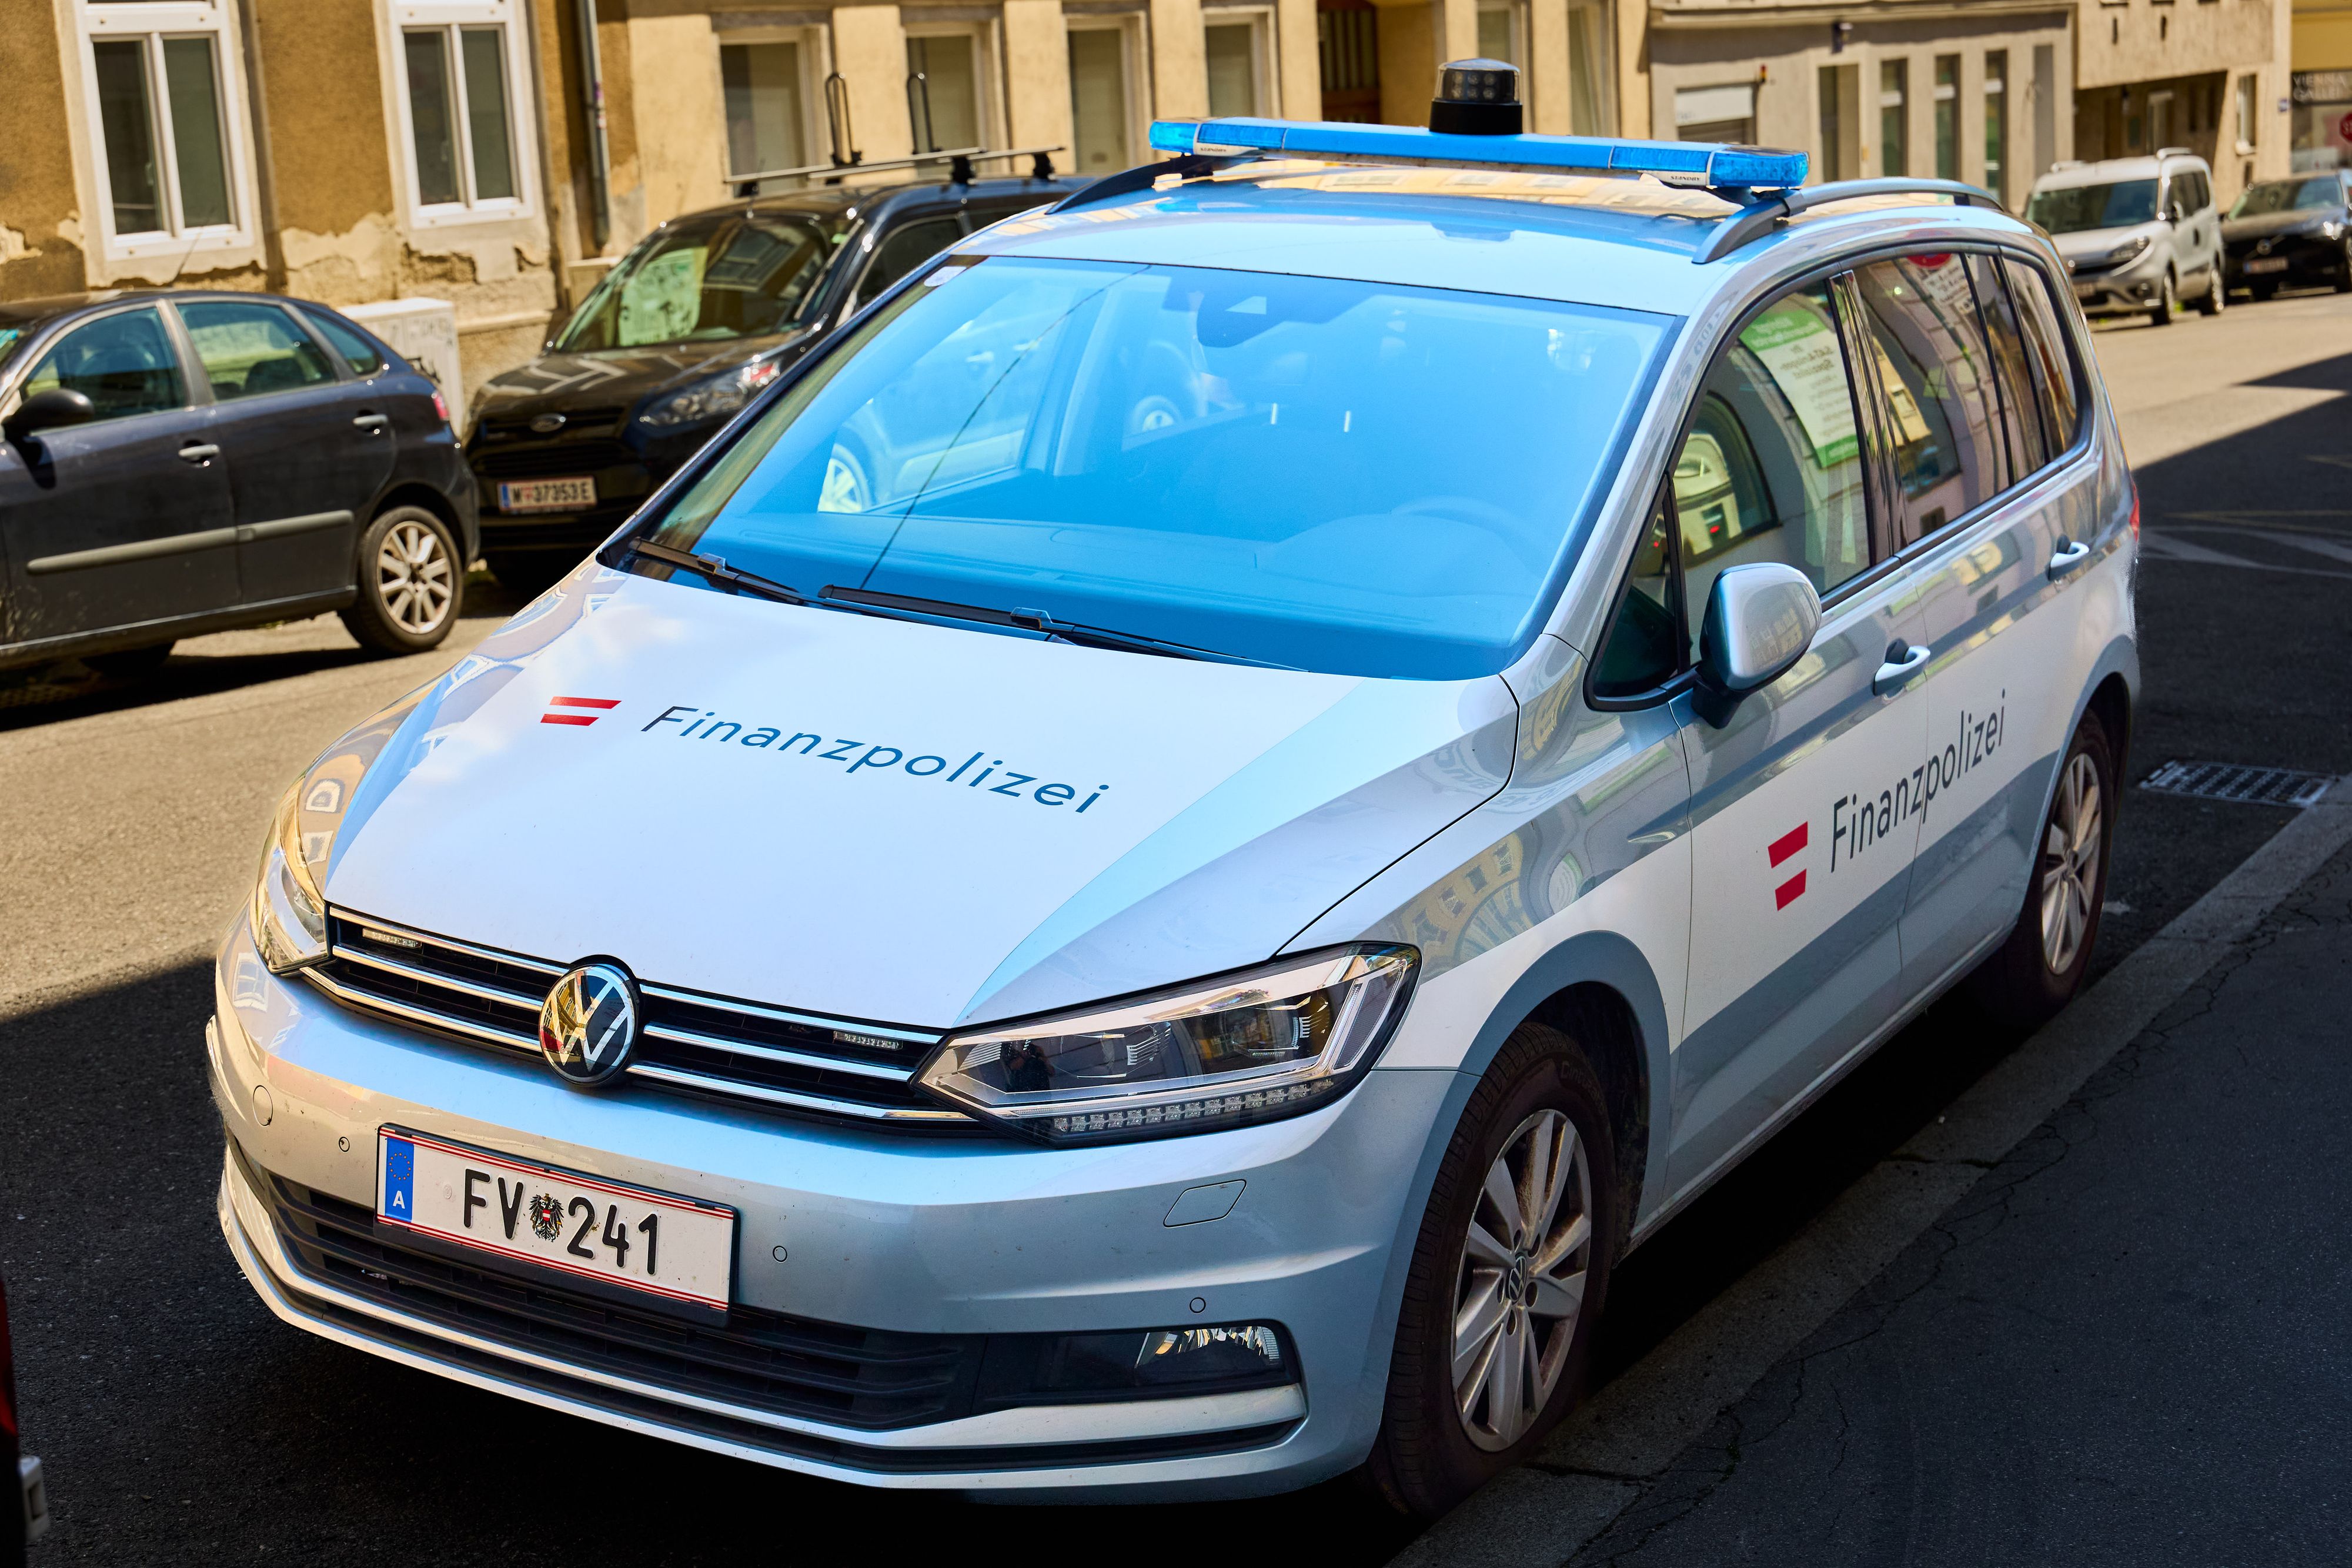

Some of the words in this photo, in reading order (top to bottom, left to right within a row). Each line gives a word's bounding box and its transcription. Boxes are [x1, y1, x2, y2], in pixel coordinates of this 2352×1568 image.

[641, 706, 1110, 813] Finanzpolizei
[1831, 688, 2006, 873] Finanzpolizei
[392, 1190, 406, 1209] A
[463, 1168, 524, 1239] FV
[566, 1196, 658, 1275] 241
